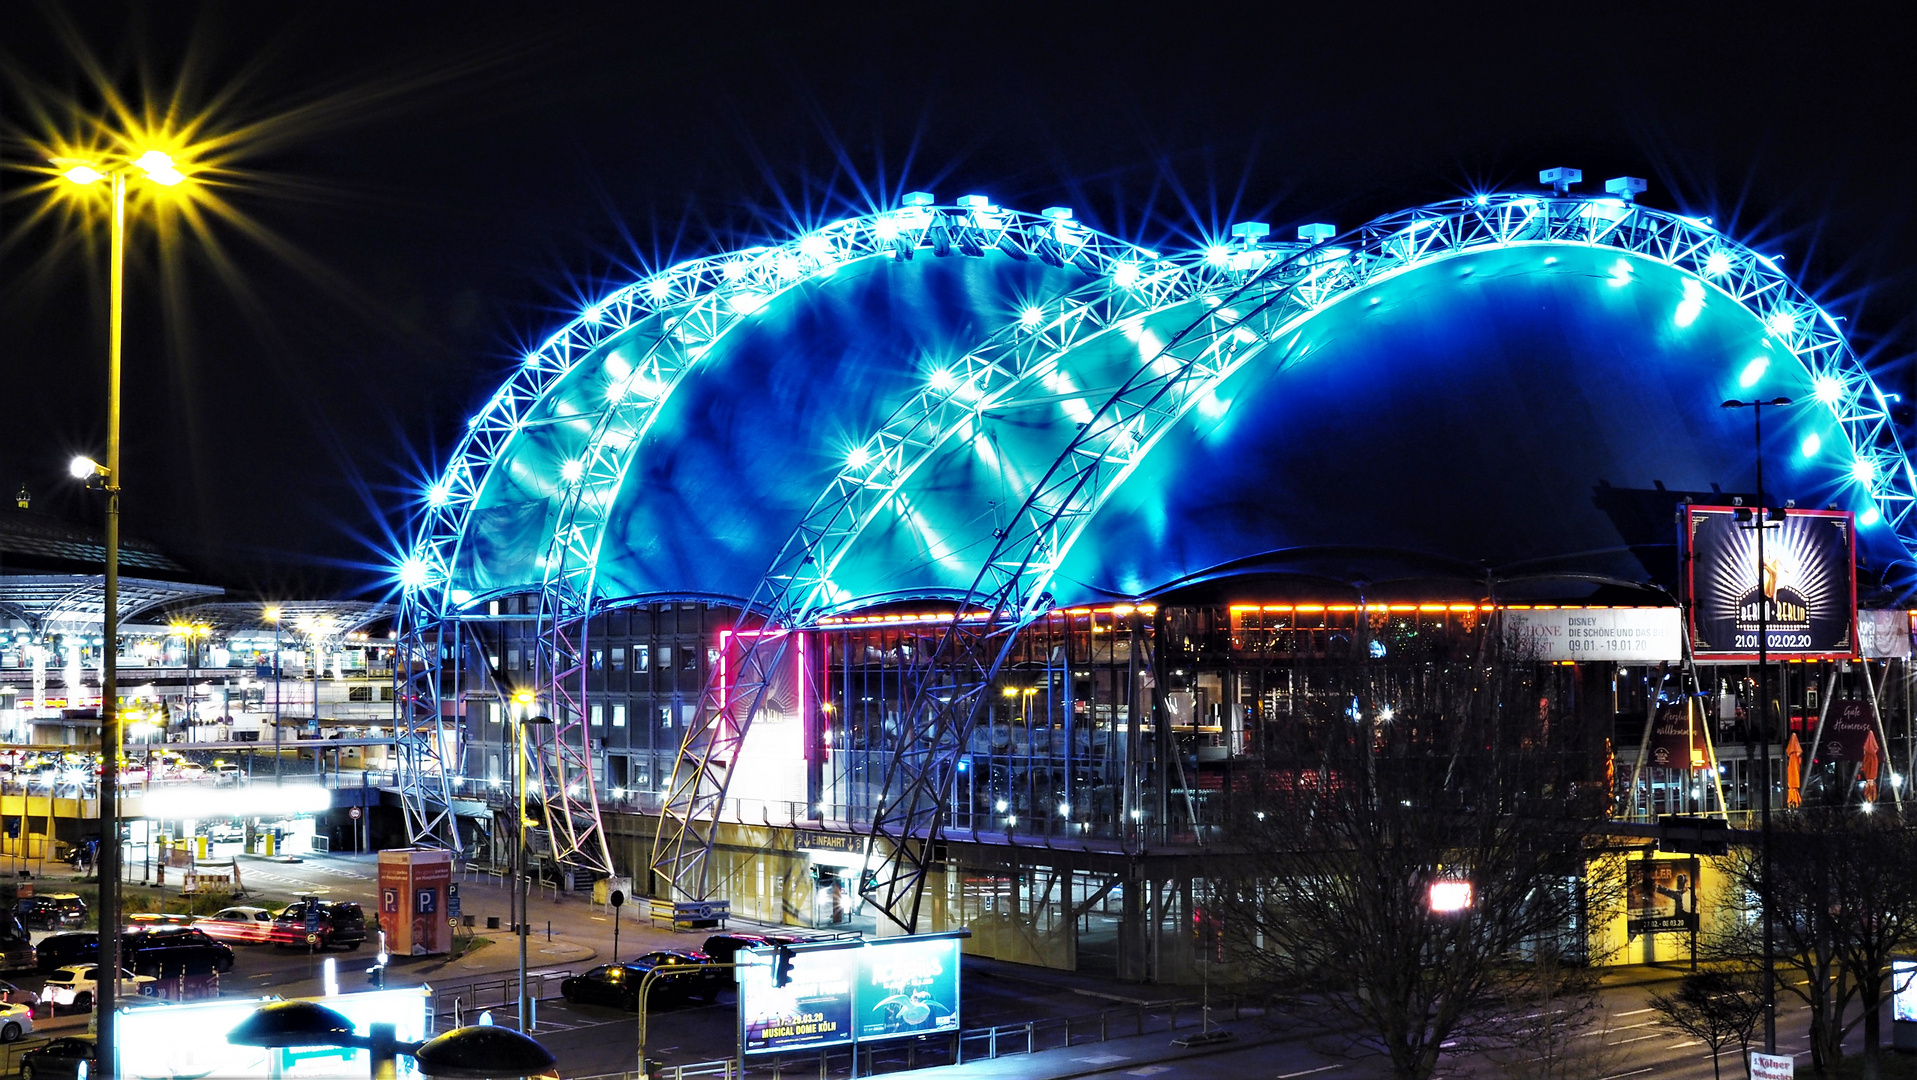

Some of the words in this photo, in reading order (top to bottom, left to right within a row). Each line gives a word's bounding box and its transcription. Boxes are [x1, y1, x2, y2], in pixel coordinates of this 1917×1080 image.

[1776, 600, 1806, 621] BERLIN
[1568, 617, 1597, 626] DISNEY
[1568, 628, 1581, 637] DIE
[1583, 626, 1614, 637] SCHÖNE
[1616, 628, 1633, 637] UND
[1635, 628, 1651, 637] DAS
[1568, 639, 1599, 651] 09.01.
[1606, 639, 1647, 651] 19.01.20
[1735, 634, 1760, 648] 21.01.
[1767, 634, 1812, 648] 02.02.20
[1843, 705, 1861, 719] Gute
[1833, 718, 1871, 731] Heimreise
[812, 835, 846, 848] EINFAHRT
[449, 886, 456, 895] P
[306, 901, 312, 910] P
[385, 892, 394, 912] P
[420, 893, 431, 912] P
[762, 1027, 794, 1039] MUSICAL
[796, 1024, 817, 1035] DOME
[818, 1020, 837, 1033] KÖLN
[1758, 1057, 1790, 1069] Kölner
